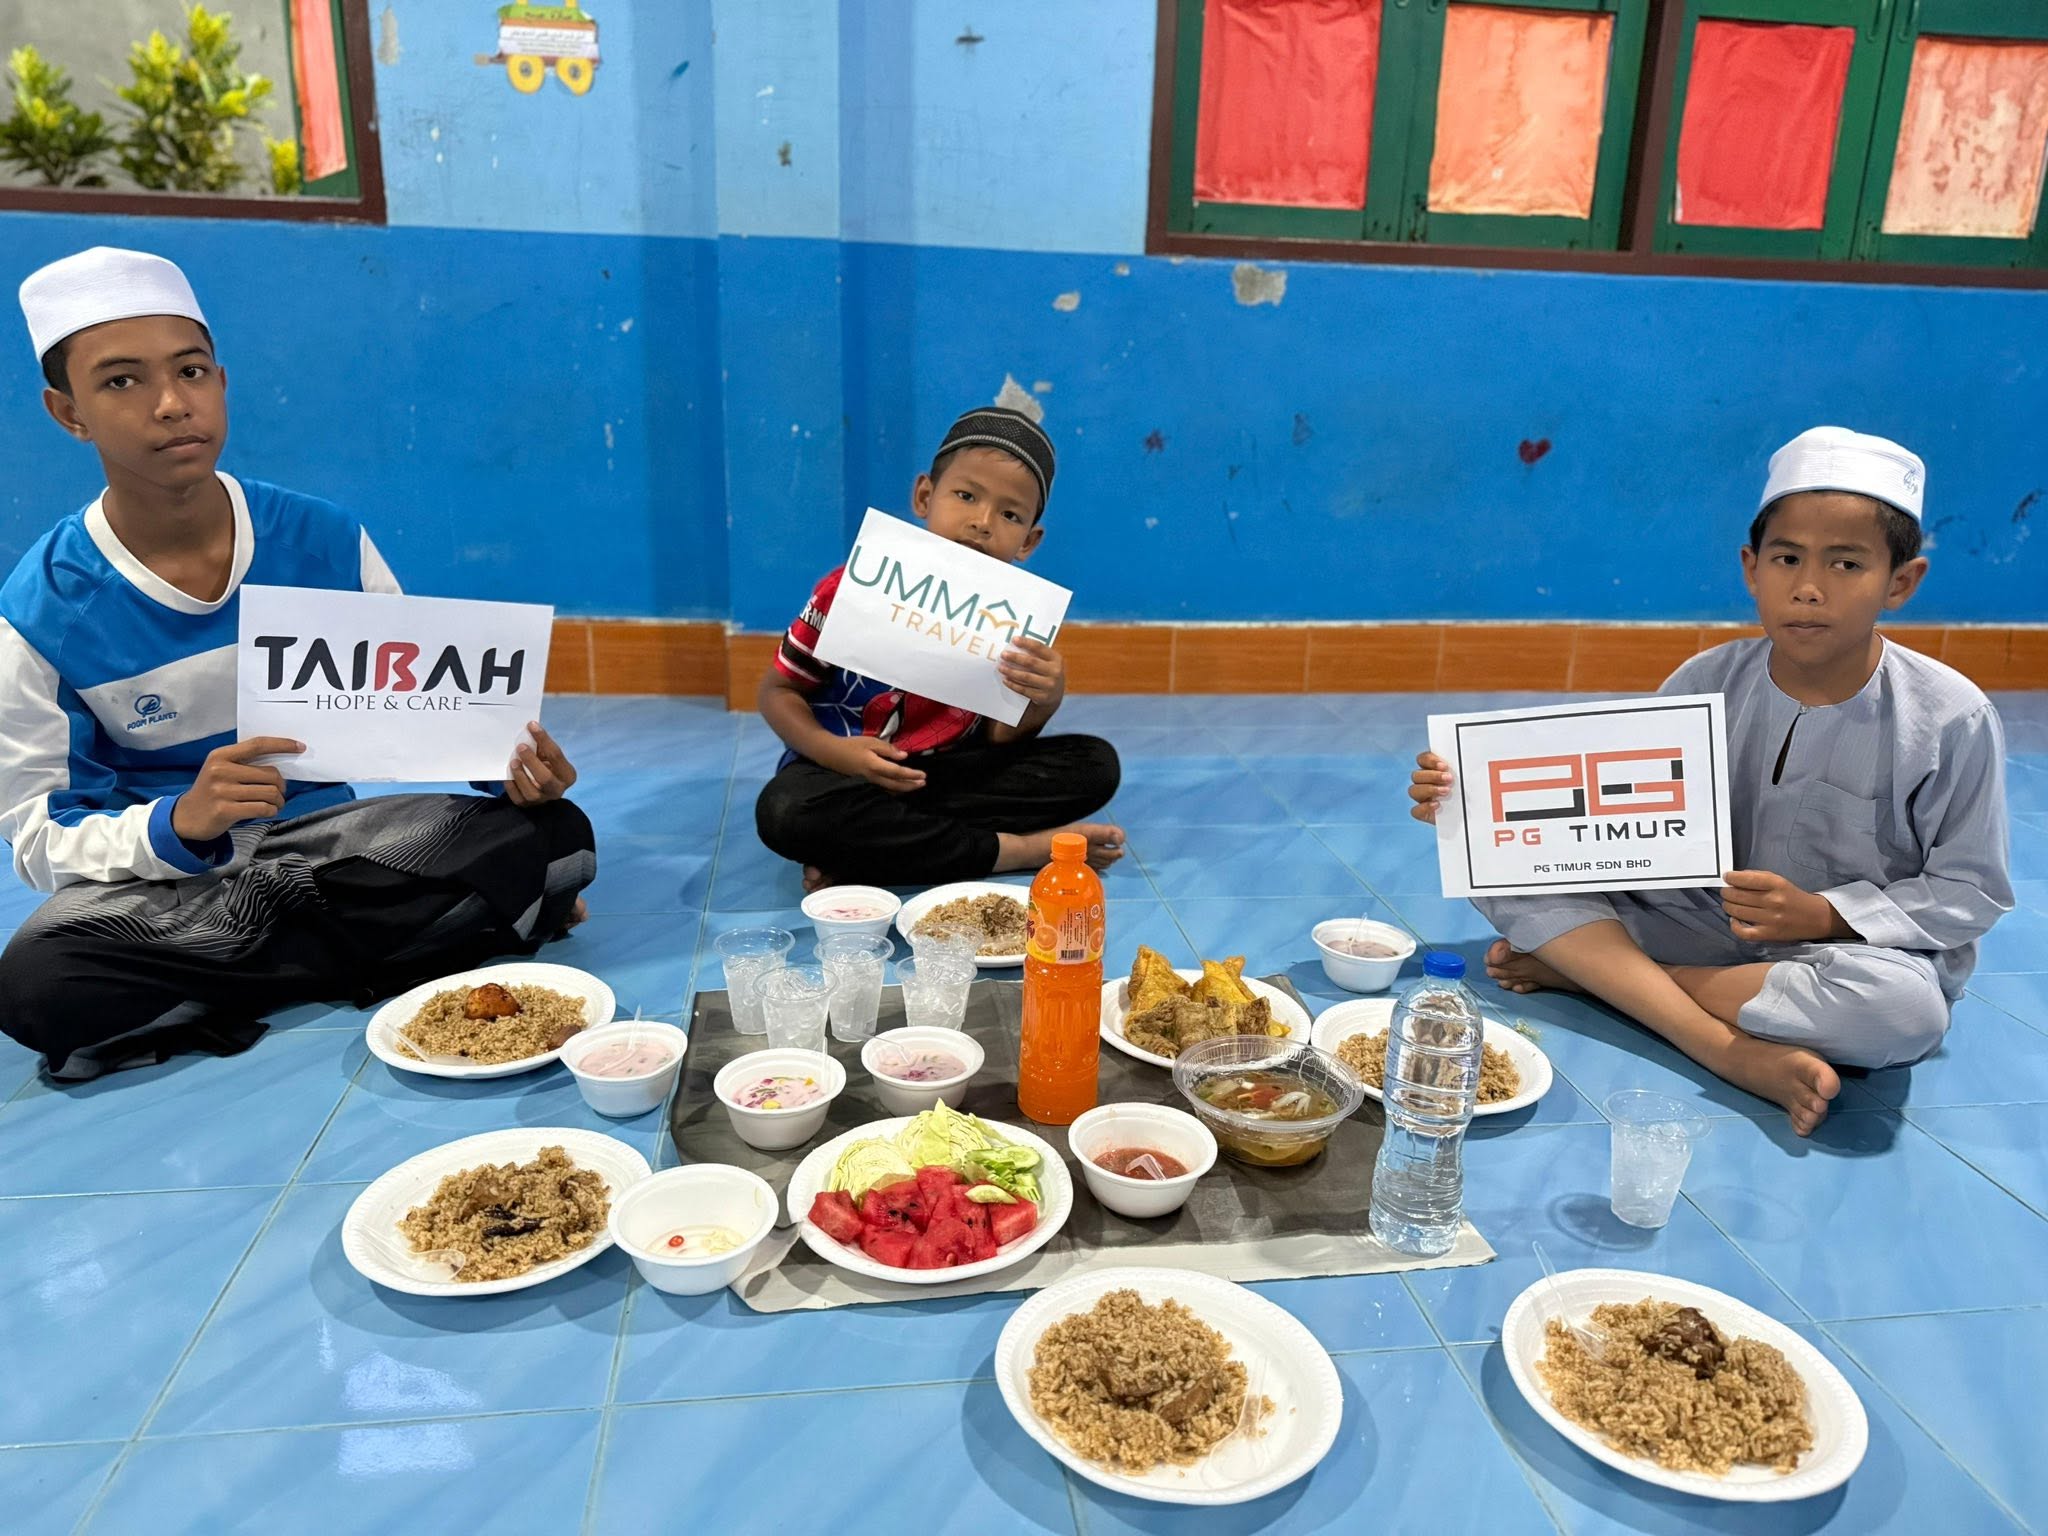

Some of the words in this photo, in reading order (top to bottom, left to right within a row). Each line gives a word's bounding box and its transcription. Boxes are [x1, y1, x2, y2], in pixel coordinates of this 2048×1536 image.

[890, 603, 999, 662] TRAVEL
[254, 636, 525, 695] TAIBAH
[316, 694, 376, 710] HOPE
[383, 696, 399, 710] &
[407, 695, 463, 711] CARE
[148, 711, 178, 724] PLANET
[1494, 827, 1542, 847] PG
[1569, 819, 1686, 842] TIMUR
[1534, 864, 1550, 873] PG
[1555, 862, 1592, 872] TIMUR
[1596, 861, 1622, 870] SDN
[1626, 858, 1652, 869] BHD
